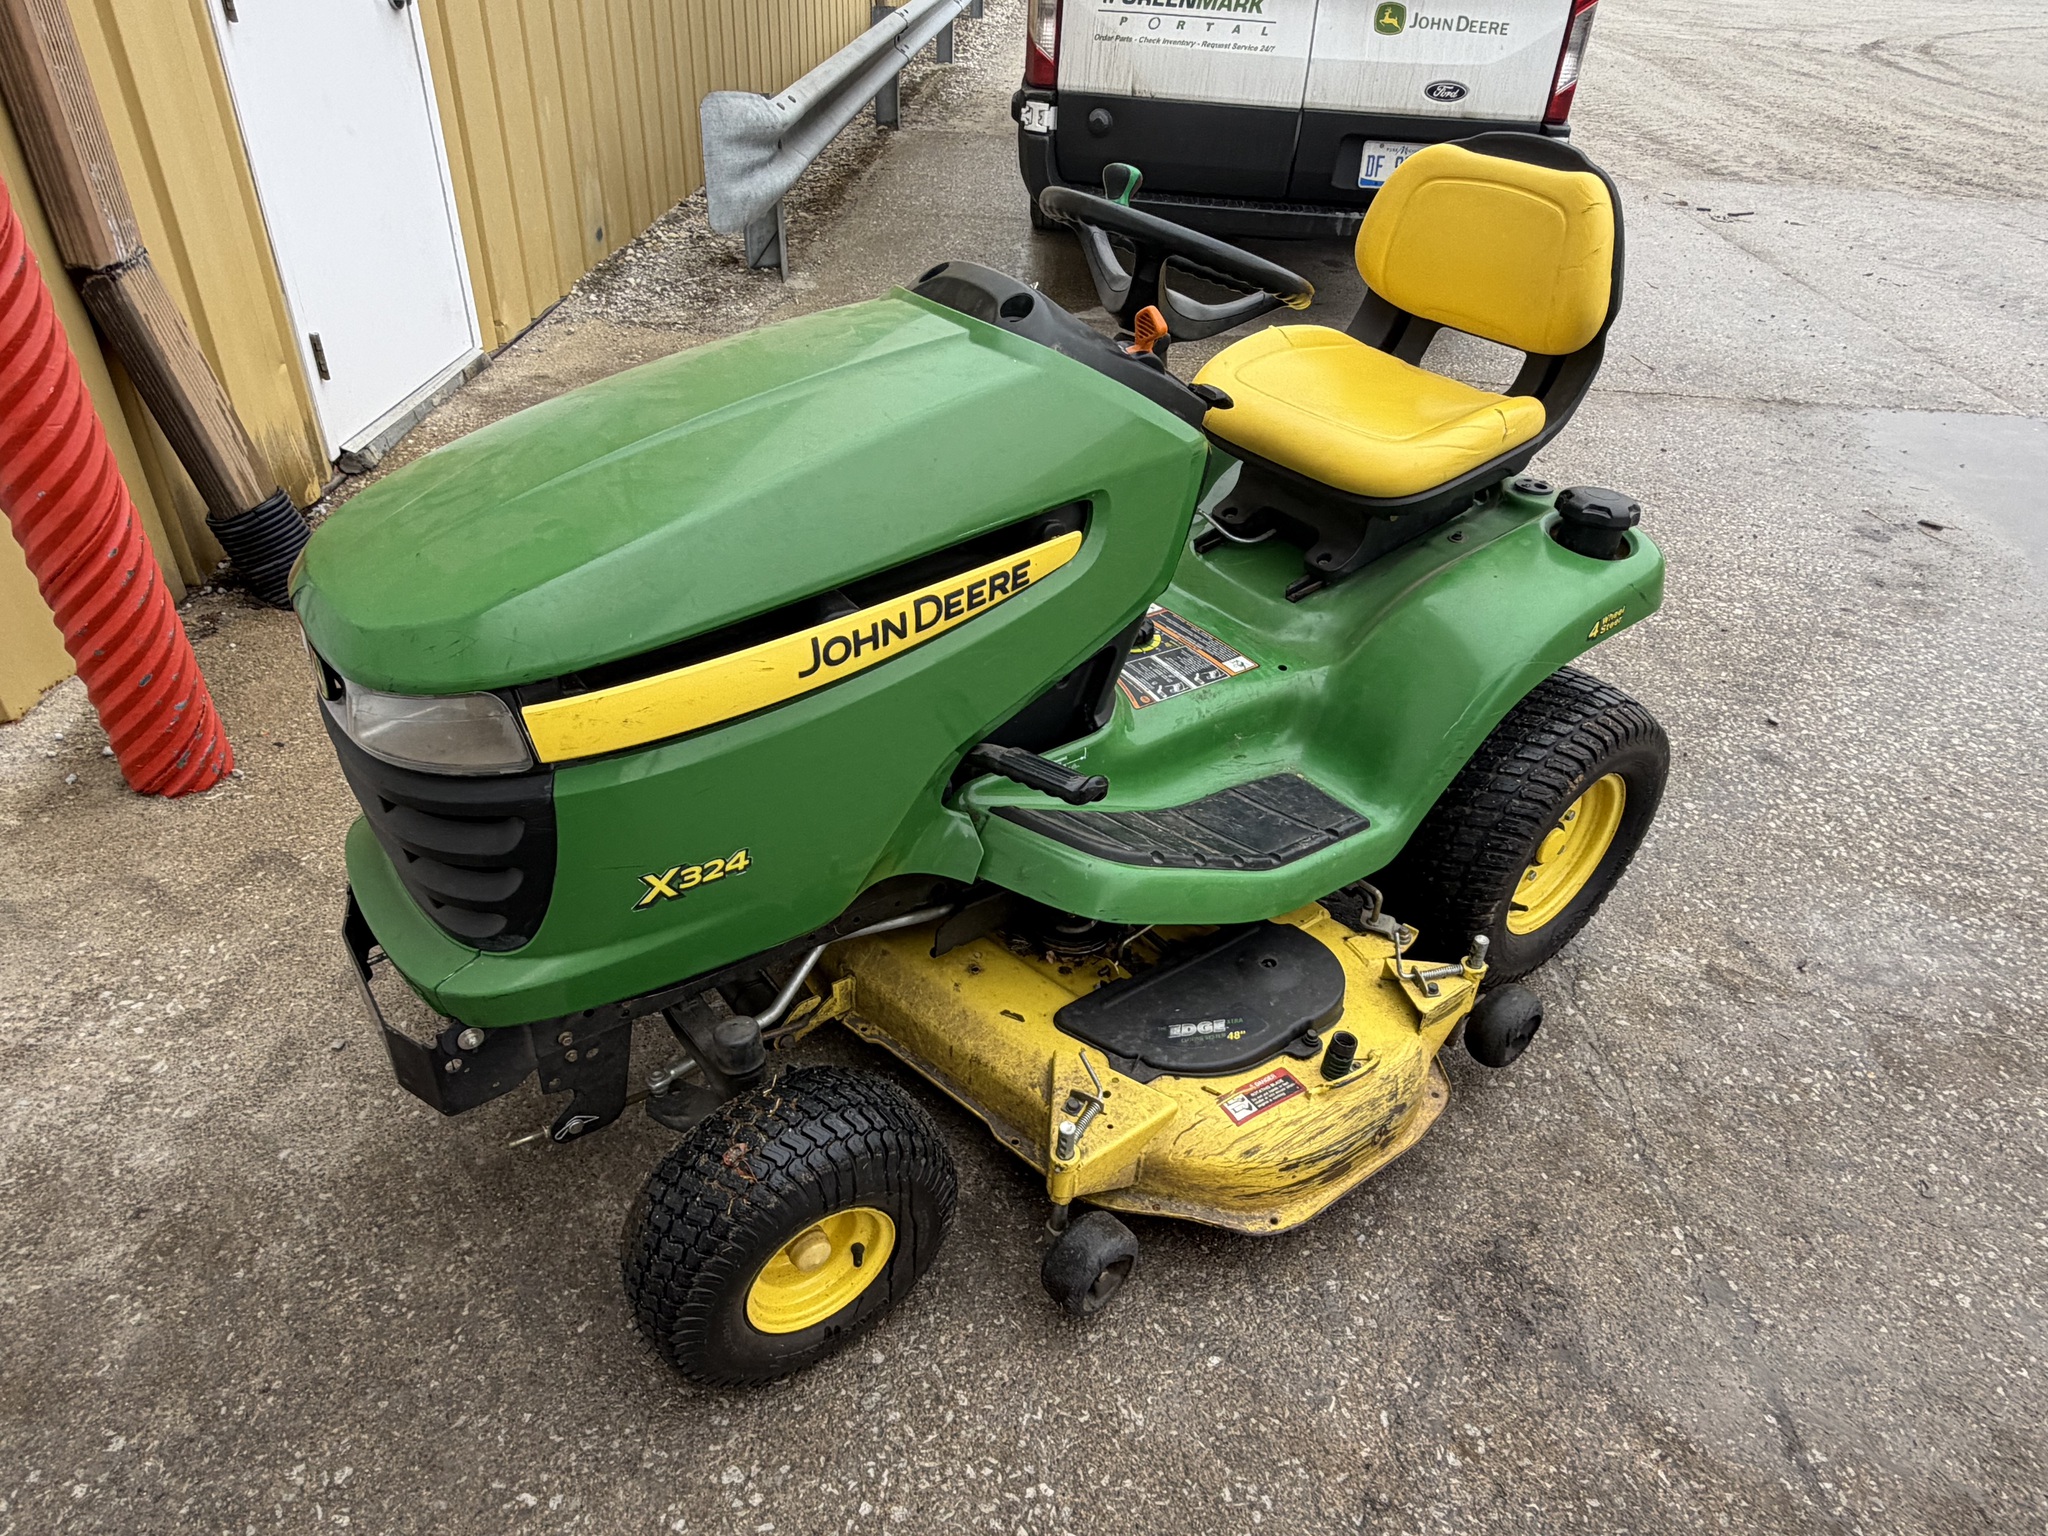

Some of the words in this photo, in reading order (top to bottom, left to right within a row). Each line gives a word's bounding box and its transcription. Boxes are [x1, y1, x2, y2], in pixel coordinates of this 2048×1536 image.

[1409, 12, 1454, 31] JOHN
[1455, 15, 1510, 36] DEERE
[1094, 33, 1114, 41] Order
[1114, 34, 1133, 43] Parts
[1138, 36, 1161, 44] Check
[1161, 38, 1196, 48] Inventory
[1201, 40, 1231, 50] Request
[1231, 43, 1259, 52] Service
[1432, 85, 1460, 98] Ford
[798, 611, 908, 679] JOHN
[913, 559, 1031, 633] DEERE
[1587, 620, 1600, 639] 4
[635, 849, 751, 907] X324
[1168, 1018, 1227, 1039] EDGE
[1253, 1073, 1278, 1088] DANGER
